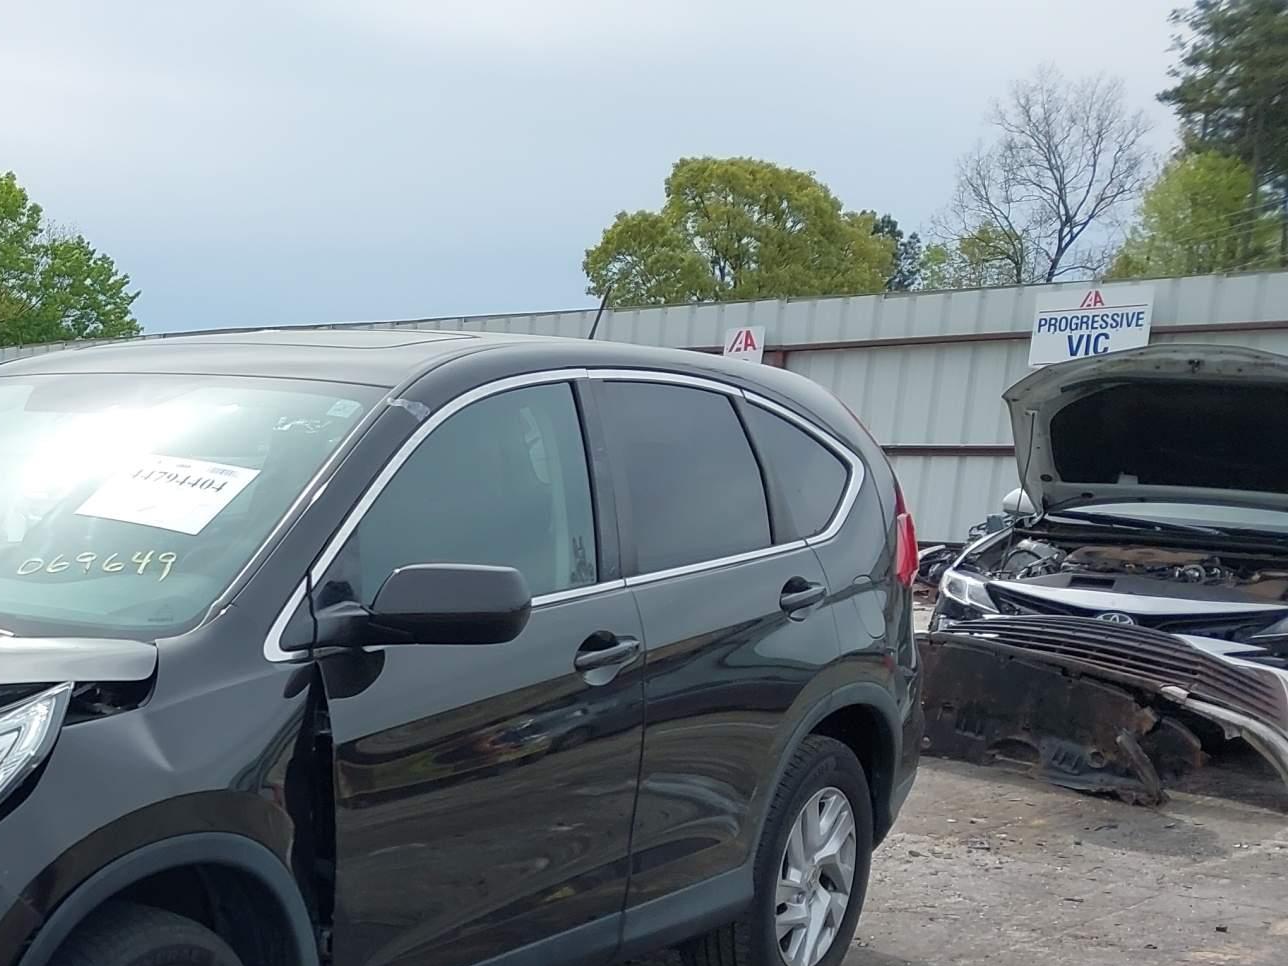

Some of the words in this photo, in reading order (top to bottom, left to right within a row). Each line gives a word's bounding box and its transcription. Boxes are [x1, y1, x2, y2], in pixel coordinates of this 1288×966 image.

[1037, 311, 1145, 333] PROGRESSIVE
[1067, 332, 1111, 357] VIC
[16, 550, 177, 582] 069649
